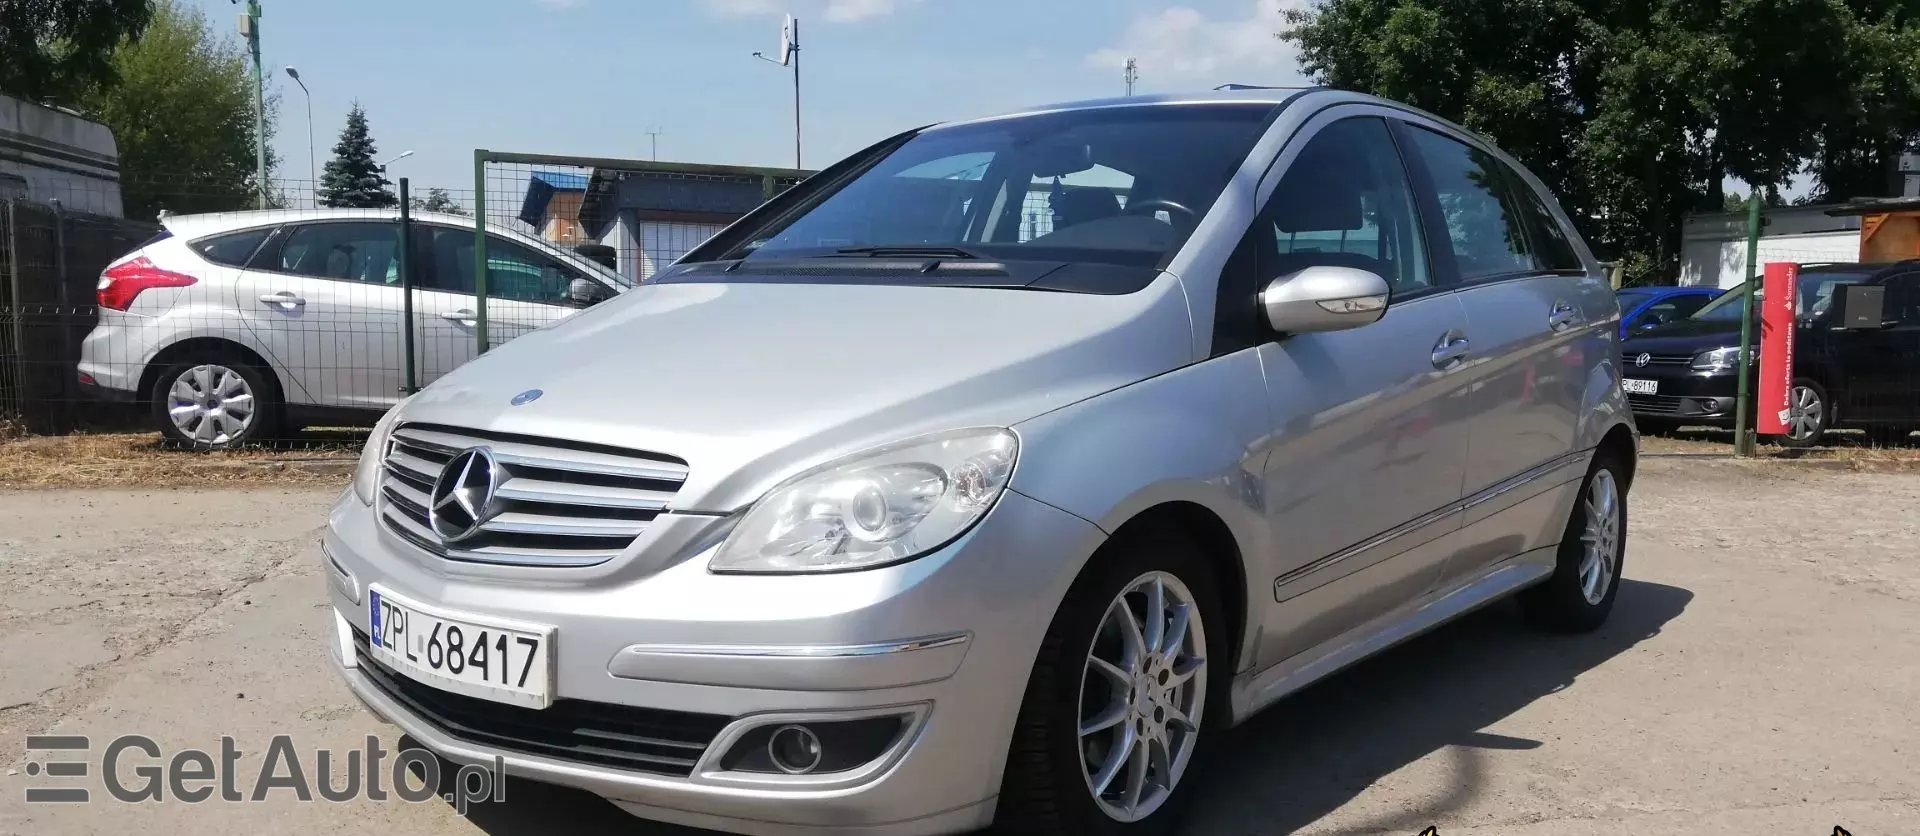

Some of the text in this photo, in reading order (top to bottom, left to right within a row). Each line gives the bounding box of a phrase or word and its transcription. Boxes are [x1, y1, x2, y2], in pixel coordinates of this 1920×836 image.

[1784, 267, 1793, 301] Santander
[1633, 381, 1656, 392] 89116
[381, 600, 539, 688] ZPL 68417
